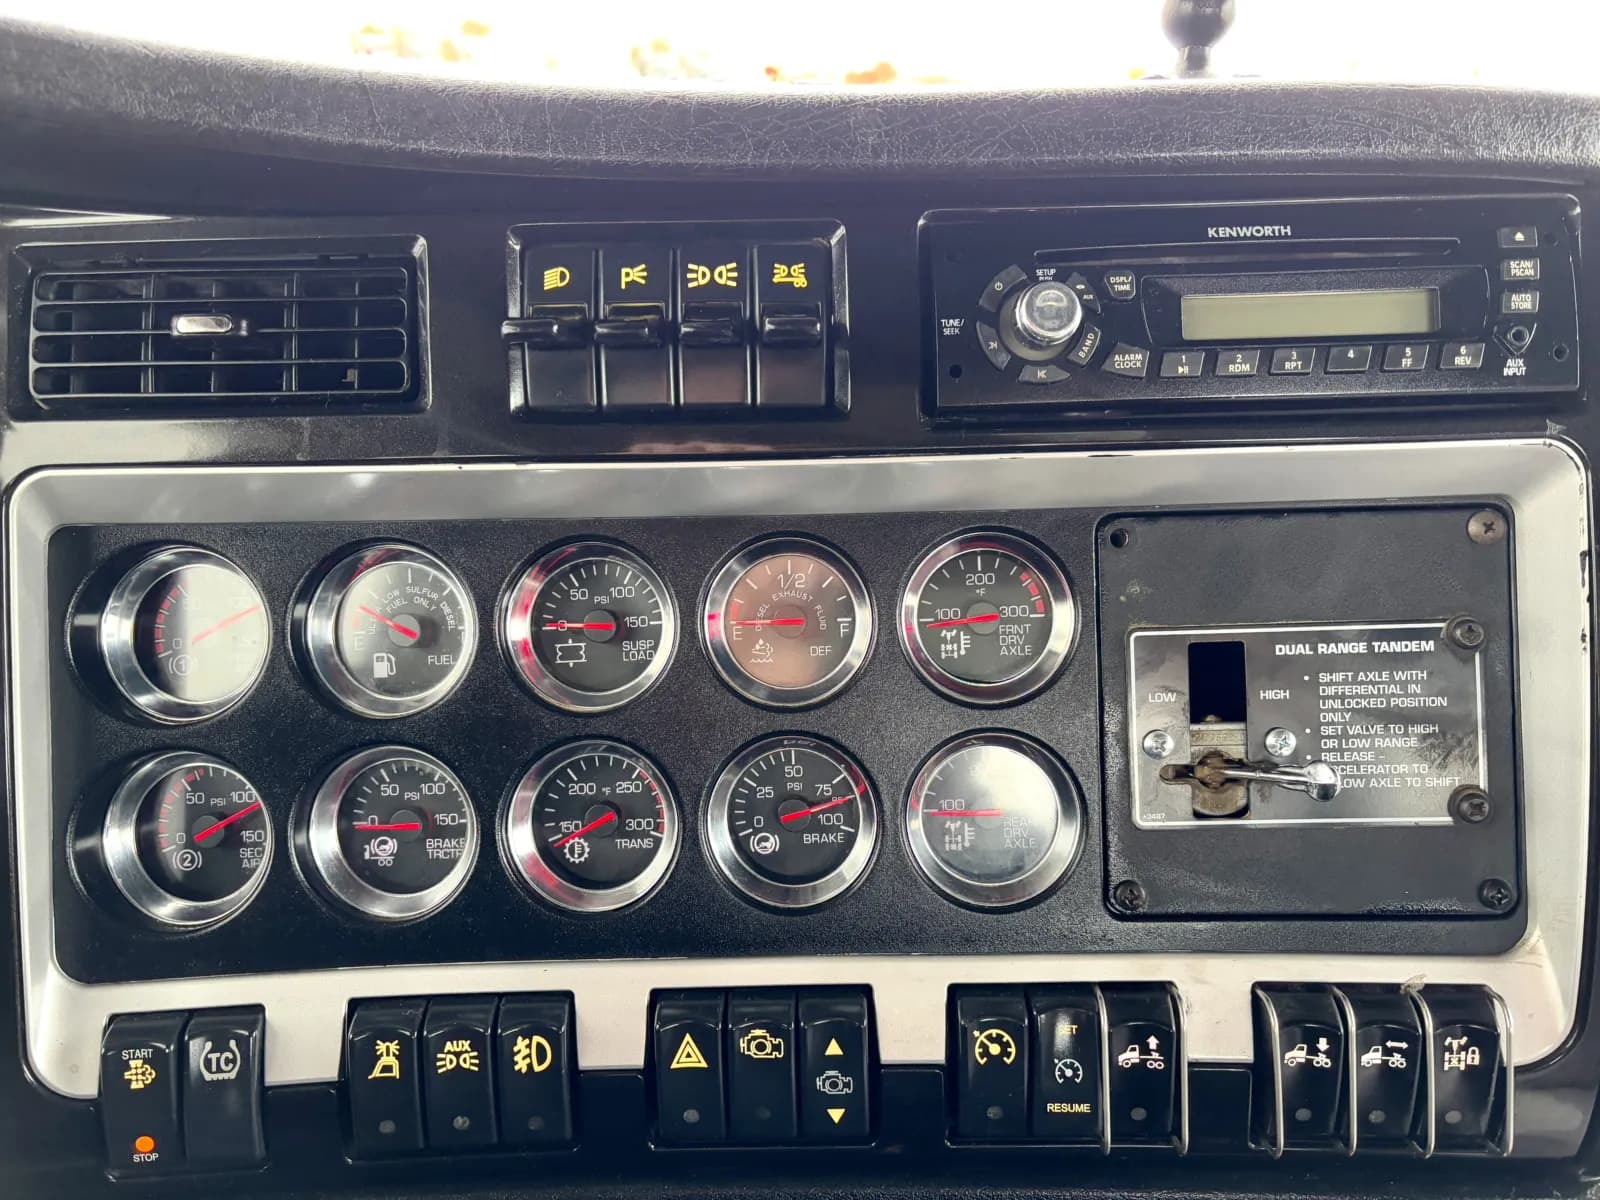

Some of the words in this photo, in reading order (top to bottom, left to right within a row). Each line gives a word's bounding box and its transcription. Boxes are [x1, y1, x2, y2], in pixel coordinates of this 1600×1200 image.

[1208, 226, 1291, 238] KENWORTH
[1510, 261, 1533, 269] SCAN/
[1036, 268, 1056, 276] SETUP
[1511, 268, 1534, 276] PSCAN
[1110, 276, 1132, 284] DSPL/
[1114, 283, 1131, 291] TIME
[1511, 294, 1531, 302] AUTO
[1511, 301, 1532, 309] STORE
[941, 319, 965, 328] TUNE/
[943, 327, 960, 335] SEEK
[1078, 332, 1095, 359] BAND
[1460, 345, 1466, 354] 6
[1114, 354, 1143, 362] ALARM
[1291, 352, 1297, 360] 3
[1348, 350, 1354, 358] 4
[1405, 348, 1411, 357] 5
[1181, 355, 1186, 363] 1
[1236, 354, 1242, 363] 2
[1402, 358, 1412, 367] FF
[1454, 356, 1472, 366] REV
[1506, 359, 1524, 368] AUX
[1114, 360, 1142, 369] CLOCK
[1229, 364, 1250, 373] RDM
[1284, 361, 1302, 370] RPT
[1504, 367, 1526, 376] INPUT
[777, 573, 806, 589] 1/2
[965, 573, 996, 586] 200
[570, 588, 589, 600] 50
[609, 586, 635, 598] 100
[386, 598, 408, 613] FUEL
[414, 596, 437, 611] ONLY
[594, 596, 610, 604] PSI
[384, 589, 400, 603] LOW
[406, 586, 439, 600] SULFUR
[440, 601, 456, 632] DIESEL
[771, 591, 814, 602] EXHAUST
[813, 604, 827, 631] FLUID
[935, 607, 961, 620] 100
[999, 605, 1030, 618] 300
[624, 616, 649, 628] 150
[733, 626, 742, 640] E
[839, 623, 849, 638] F
[999, 624, 1032, 635] FRNT
[622, 640, 655, 650] SUSP
[999, 635, 1025, 646] DRV
[810, 645, 832, 657] DEF
[1000, 645, 1032, 656] AXLE
[1275, 643, 1314, 656] DUAL
[1317, 642, 1368, 655] RANGE
[1372, 640, 1435, 653] TANDEM
[428, 655, 457, 665] FUEL
[623, 651, 656, 662] LOAD
[1319, 672, 1354, 682] SHIFT
[1357, 671, 1390, 682] AXLE
[1393, 670, 1427, 680] WITH
[1260, 689, 1290, 700] HIGH
[1320, 684, 1404, 695] DIFFERENTIAL
[1407, 684, 1421, 694] IN
[1148, 692, 1176, 703] LOW
[1320, 698, 1386, 709] UNLOCKED
[1391, 697, 1448, 708] POSITION
[1320, 712, 1352, 722] ONLY
[1321, 725, 1344, 735] SET
[1346, 724, 1385, 735] VALVE
[1388, 724, 1404, 734] TO
[1408, 723, 1439, 734] HIGH
[1321, 738, 1338, 749] OR
[1342, 738, 1371, 748] LOW
[1375, 737, 1418, 748] RANGE
[1322, 751, 1375, 761] RELEASE
[784, 766, 803, 778] 50
[1332, 764, 1409, 775] CELERATOR
[1412, 763, 1428, 774] TO
[616, 781, 642, 794] 250
[787, 782, 803, 791] PSI
[1370, 777, 1400, 788] AXLE
[1405, 777, 1421, 787] TO
[1425, 776, 1461, 787] SHIFT
[380, 784, 400, 796] 50
[420, 783, 446, 795] 100
[568, 783, 596, 795] 200
[756, 787, 774, 799] 25
[815, 784, 832, 796] 75
[185, 792, 205, 805] 50
[210, 797, 226, 806] PSI
[230, 791, 256, 804] 100
[404, 792, 420, 801] PSI
[939, 799, 965, 811] 100
[434, 814, 459, 825] 150
[754, 816, 764, 828] 0
[817, 813, 844, 825] 100
[559, 821, 582, 833] 150
[625, 819, 654, 831] 300
[176, 832, 186, 844] 0
[240, 830, 265, 843] 150
[1003, 827, 1029, 838] DRV
[426, 838, 465, 849] BRAKE
[616, 838, 654, 850] TRANS
[803, 833, 845, 845] BRAKE
[1004, 838, 1037, 849] AXLE
[239, 848, 263, 859] SEC
[241, 859, 261, 869] AIR
[444, 1040, 471, 1052] AUX
[121, 1049, 154, 1061] START
[208, 1052, 234, 1072] TC
[1047, 1104, 1091, 1113] RESUME
[133, 1153, 159, 1163] STOP
